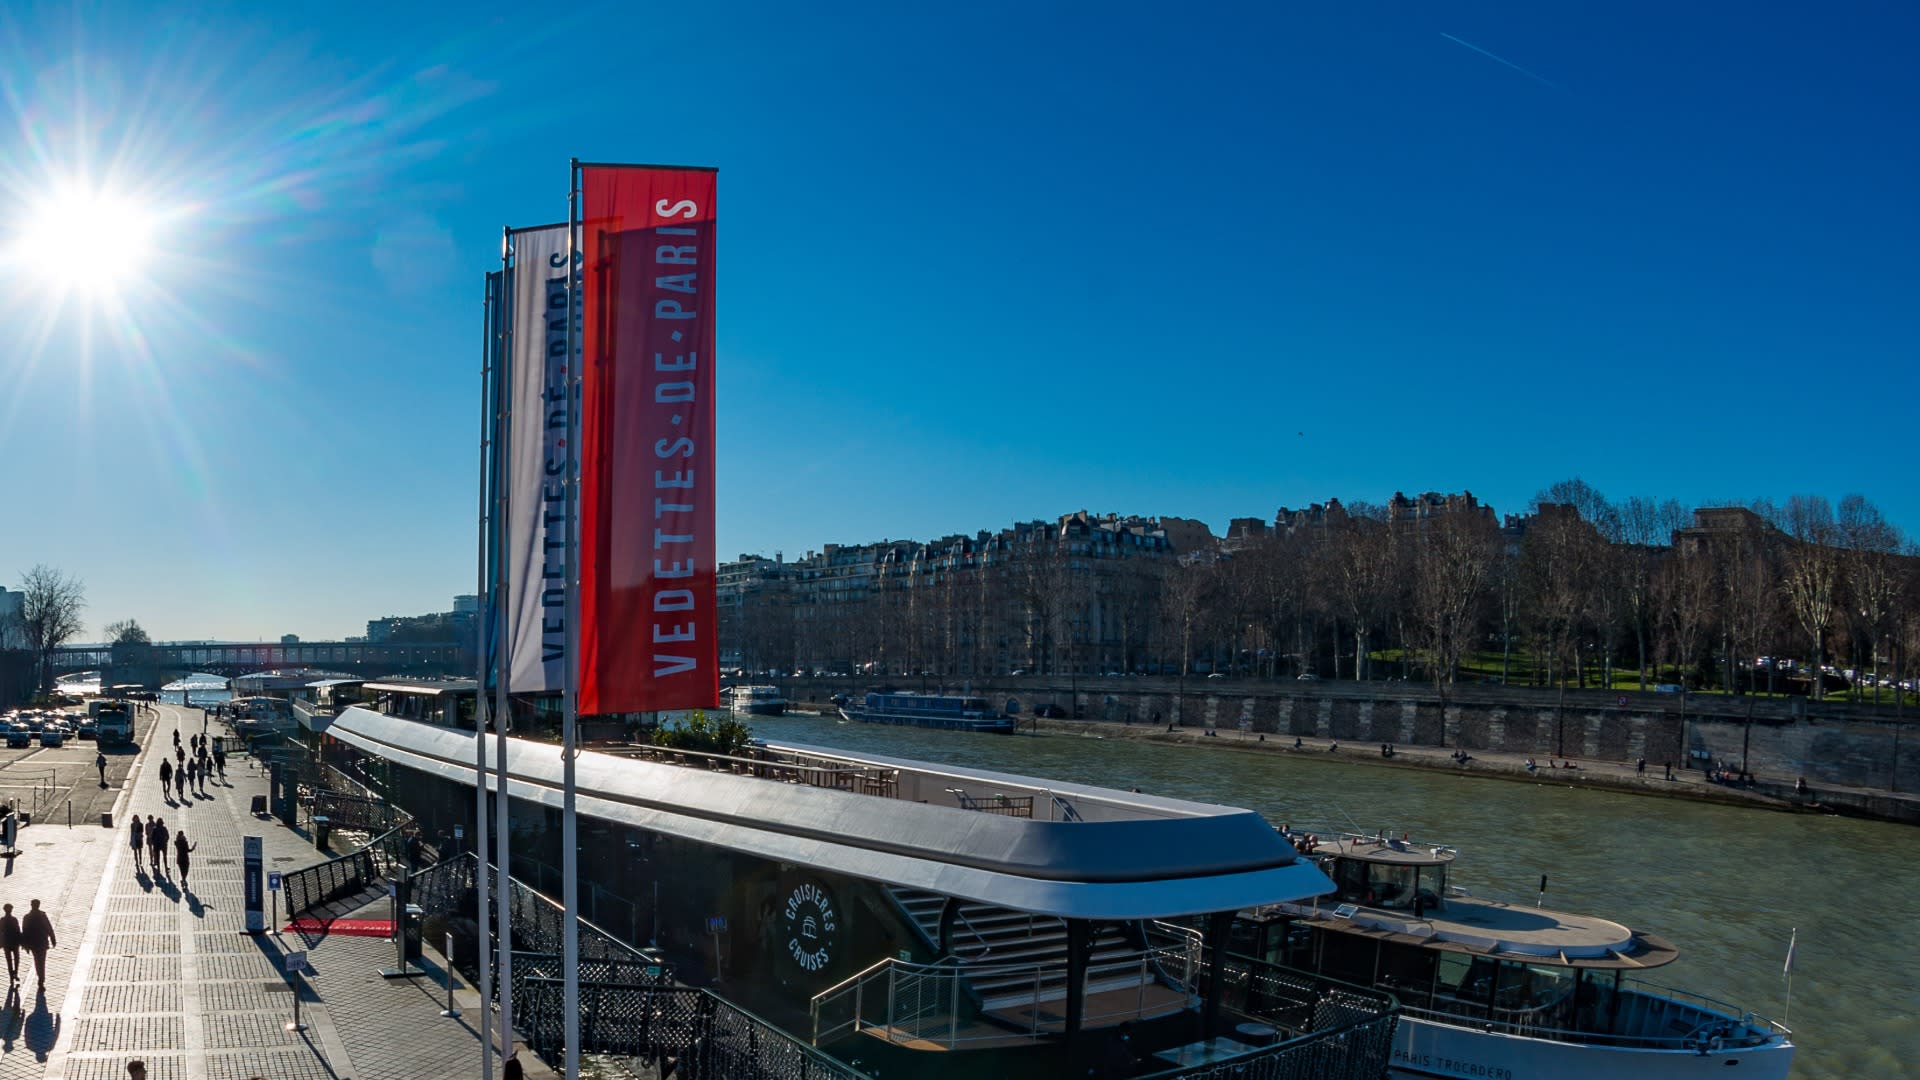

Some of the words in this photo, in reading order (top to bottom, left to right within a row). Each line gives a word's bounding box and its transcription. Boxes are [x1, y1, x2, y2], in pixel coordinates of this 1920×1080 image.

[655, 198, 698, 320] PARIS
[655, 351, 697, 403] DE
[653, 437, 697, 678] VEDETTES
[785, 883, 835, 932] CROISIERES
[789, 938, 830, 972] CRUISES
[1394, 1049, 1430, 1067] PARIS
[1437, 1057, 1513, 1080] TROCADERO
